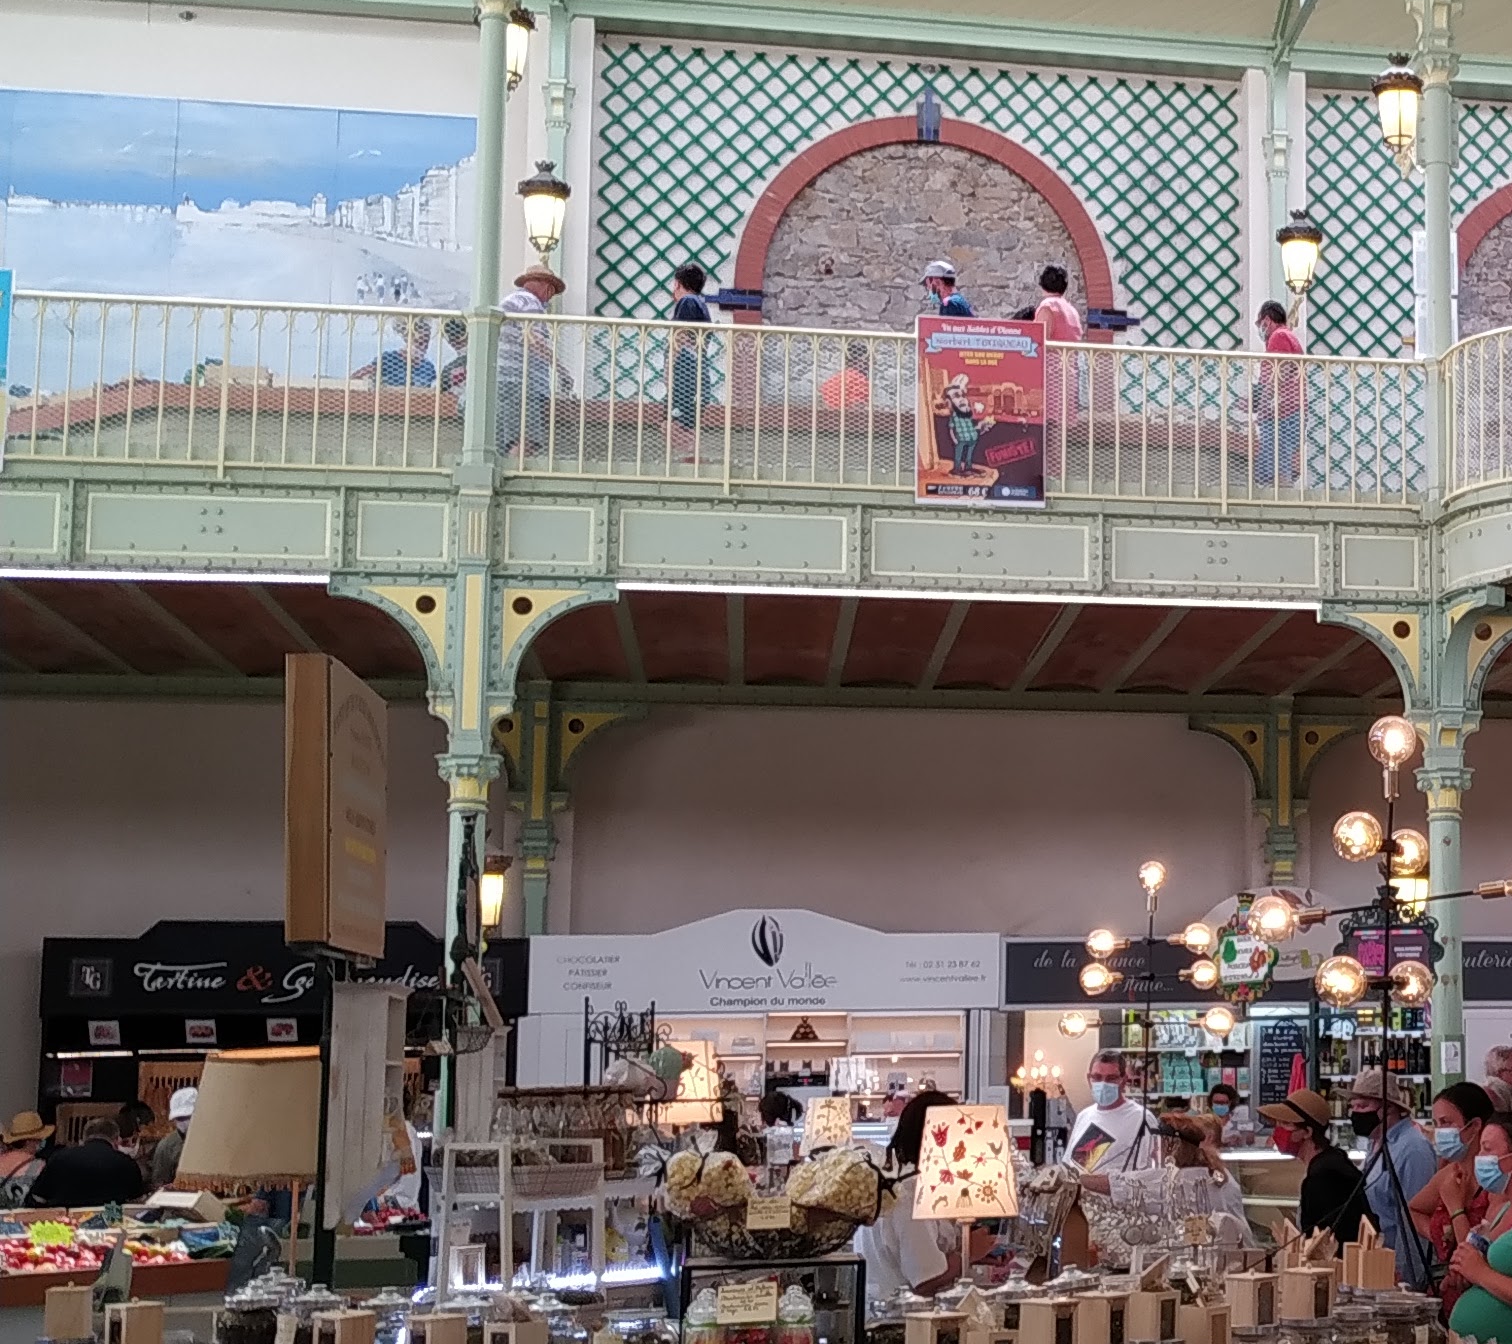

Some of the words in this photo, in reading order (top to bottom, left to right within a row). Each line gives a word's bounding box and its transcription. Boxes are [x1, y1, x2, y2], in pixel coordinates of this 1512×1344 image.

[556, 955, 620, 964] CHOCOLATIER
[134, 961, 228, 992] Tartine
[237, 965, 272, 991] &
[699, 968, 772, 990] Vincent
[776, 961, 837, 989] Vallée
[562, 981, 612, 991] CONFISEUR
[710, 996, 768, 1007] Champion
[770, 996, 785, 1006] du
[788, 996, 826, 1006] monde
